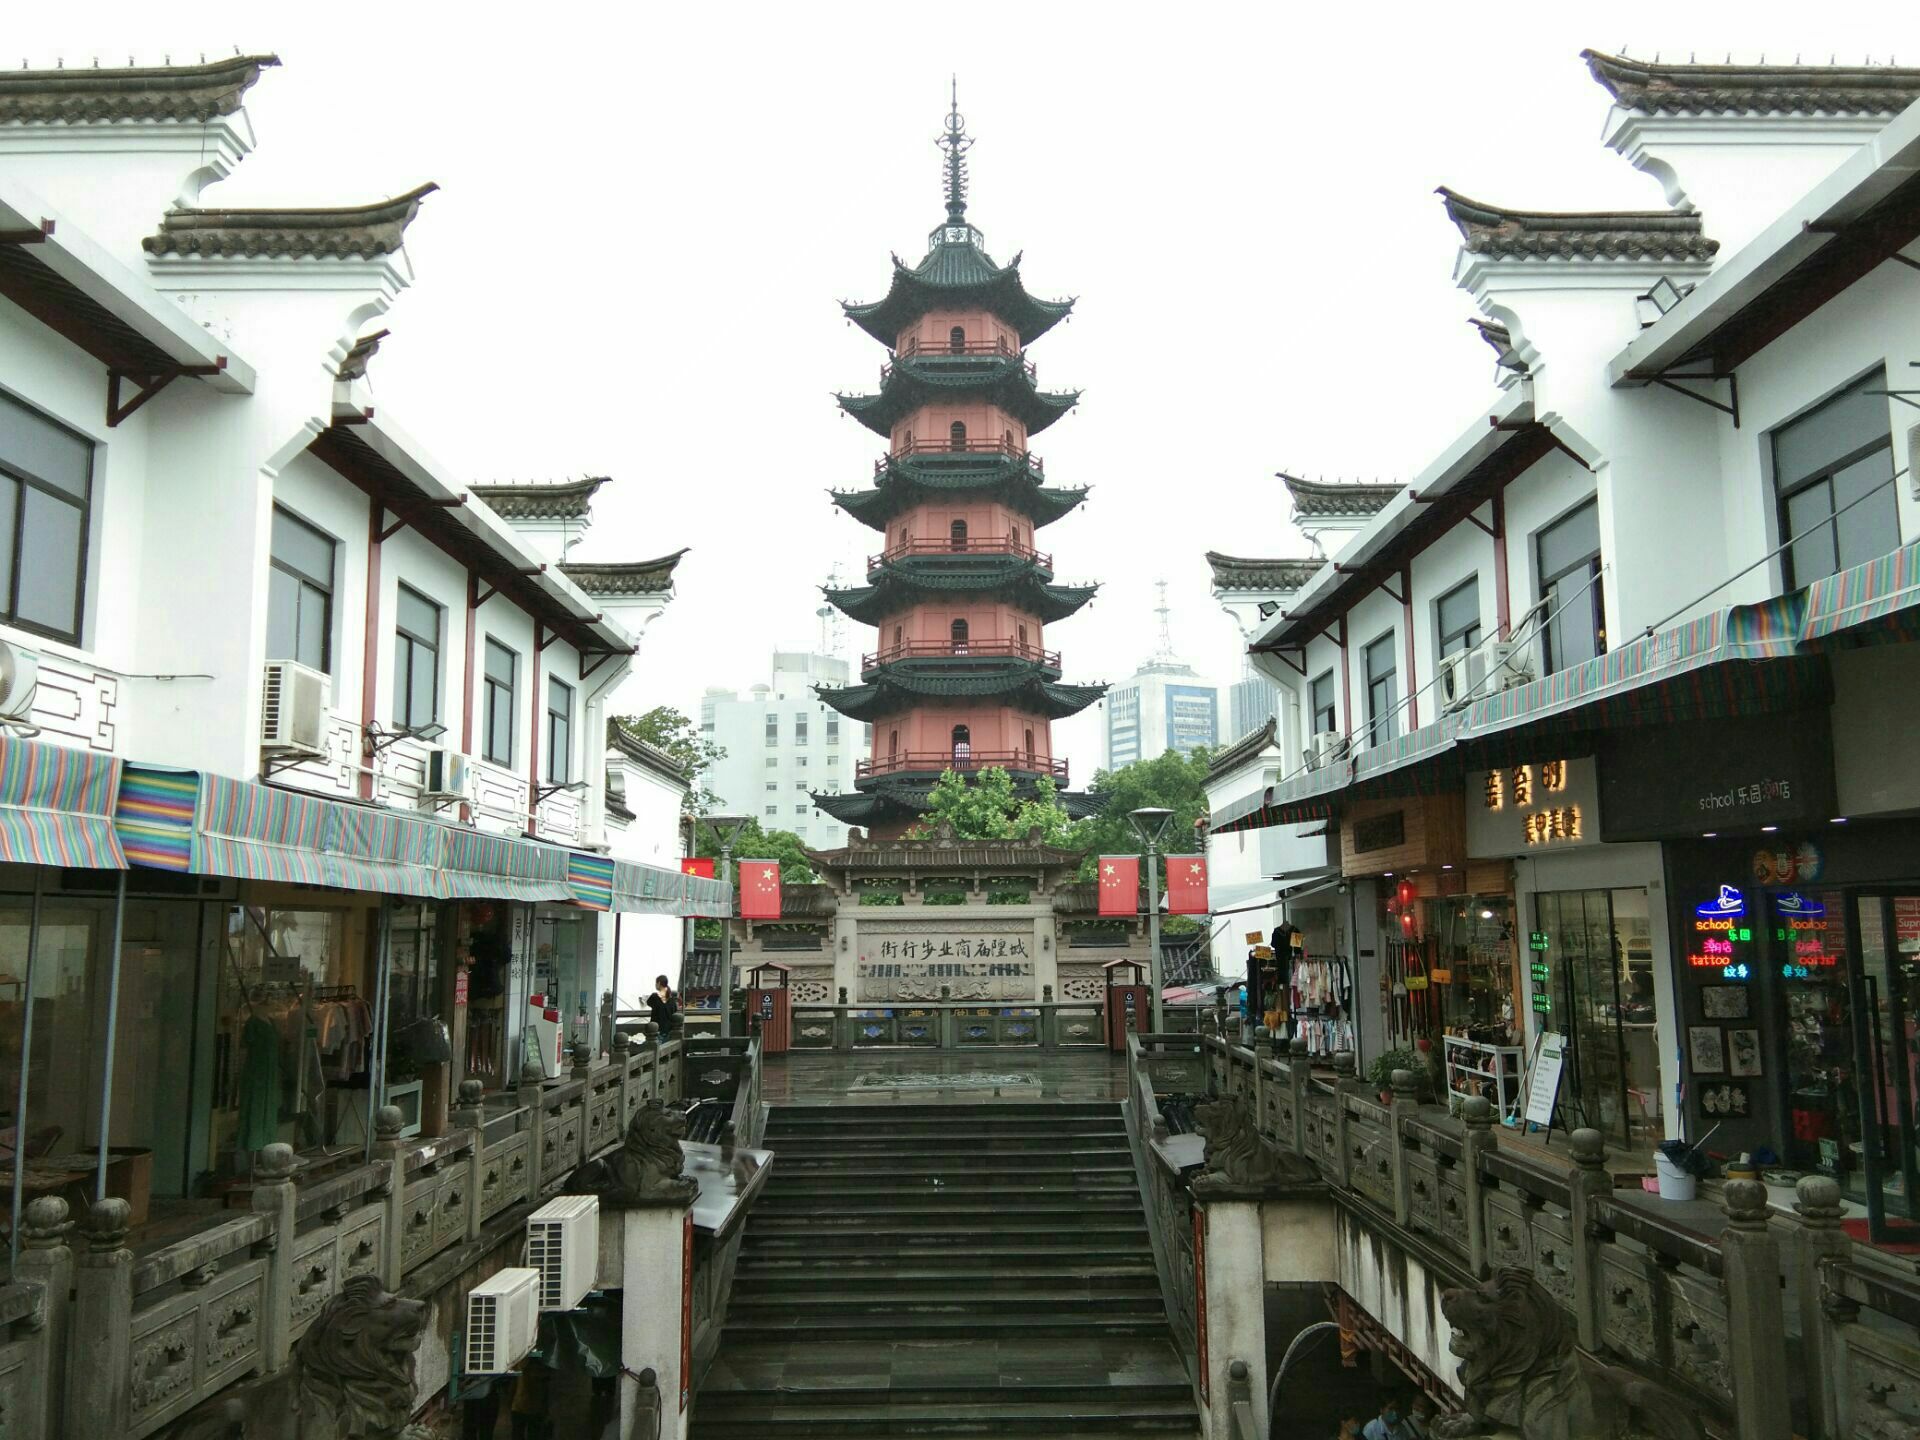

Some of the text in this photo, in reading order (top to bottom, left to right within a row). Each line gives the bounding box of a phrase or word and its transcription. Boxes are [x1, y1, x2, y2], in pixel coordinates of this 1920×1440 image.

[1699, 779, 1791, 811] school 乐园潮店
[1696, 918, 1735, 930] school
[1728, 929, 1751, 942] 乐园
[881, 938, 1029, 961] 城隍庙商业步行街
[1703, 938, 1732, 953] 潮店
[1690, 954, 1731, 966] tattoo
[1723, 964, 1748, 978] 纹身
